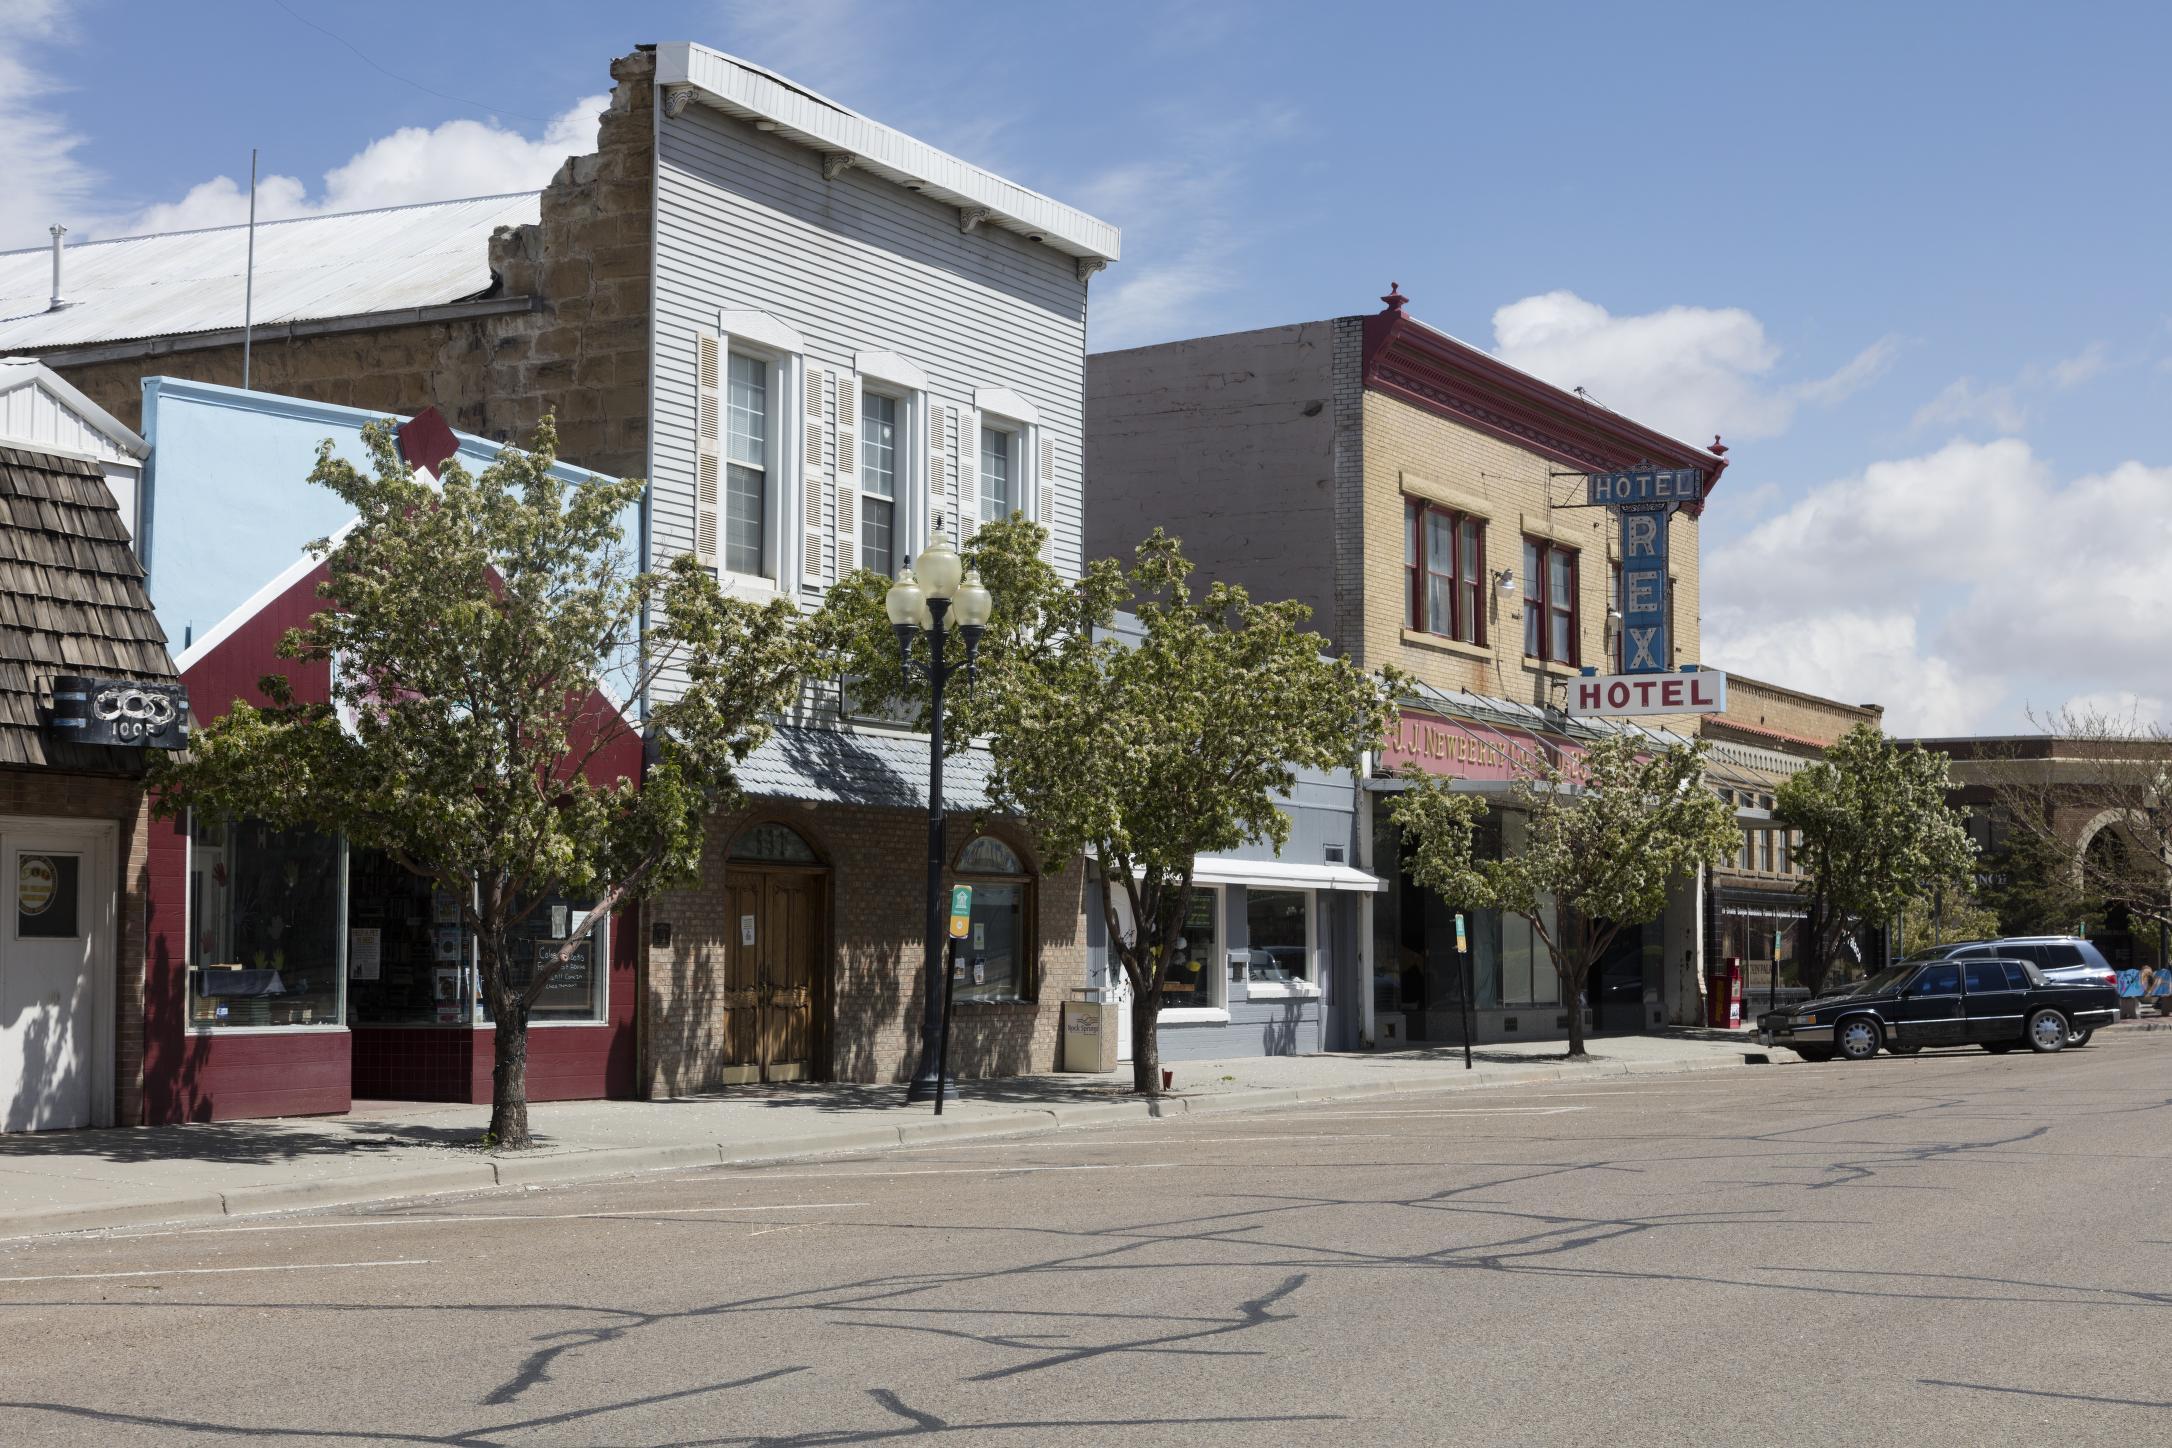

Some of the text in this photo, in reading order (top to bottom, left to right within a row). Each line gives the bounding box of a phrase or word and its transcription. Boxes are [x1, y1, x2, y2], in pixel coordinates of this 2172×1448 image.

[1595, 473, 1692, 499] HOTEL
[1628, 515, 1658, 669] REX
[1579, 679, 1713, 710] HOTEL
